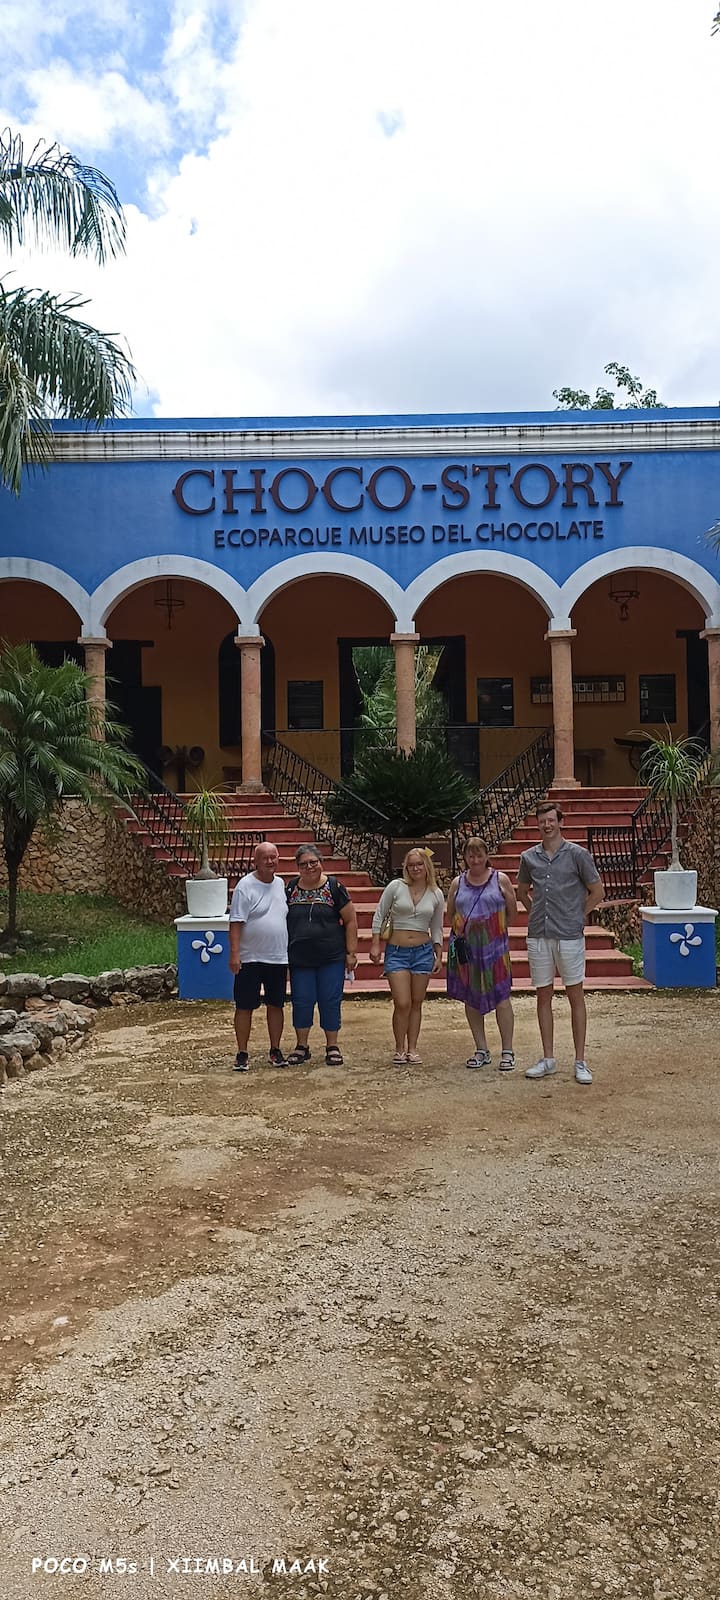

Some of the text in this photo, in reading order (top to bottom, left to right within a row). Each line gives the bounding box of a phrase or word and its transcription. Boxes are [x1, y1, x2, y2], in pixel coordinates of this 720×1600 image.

[172, 461, 633, 515] CHOCO-STORY
[214, 520, 605, 548] ECOPARQUE MUSEO DEL CHOCOLATE
